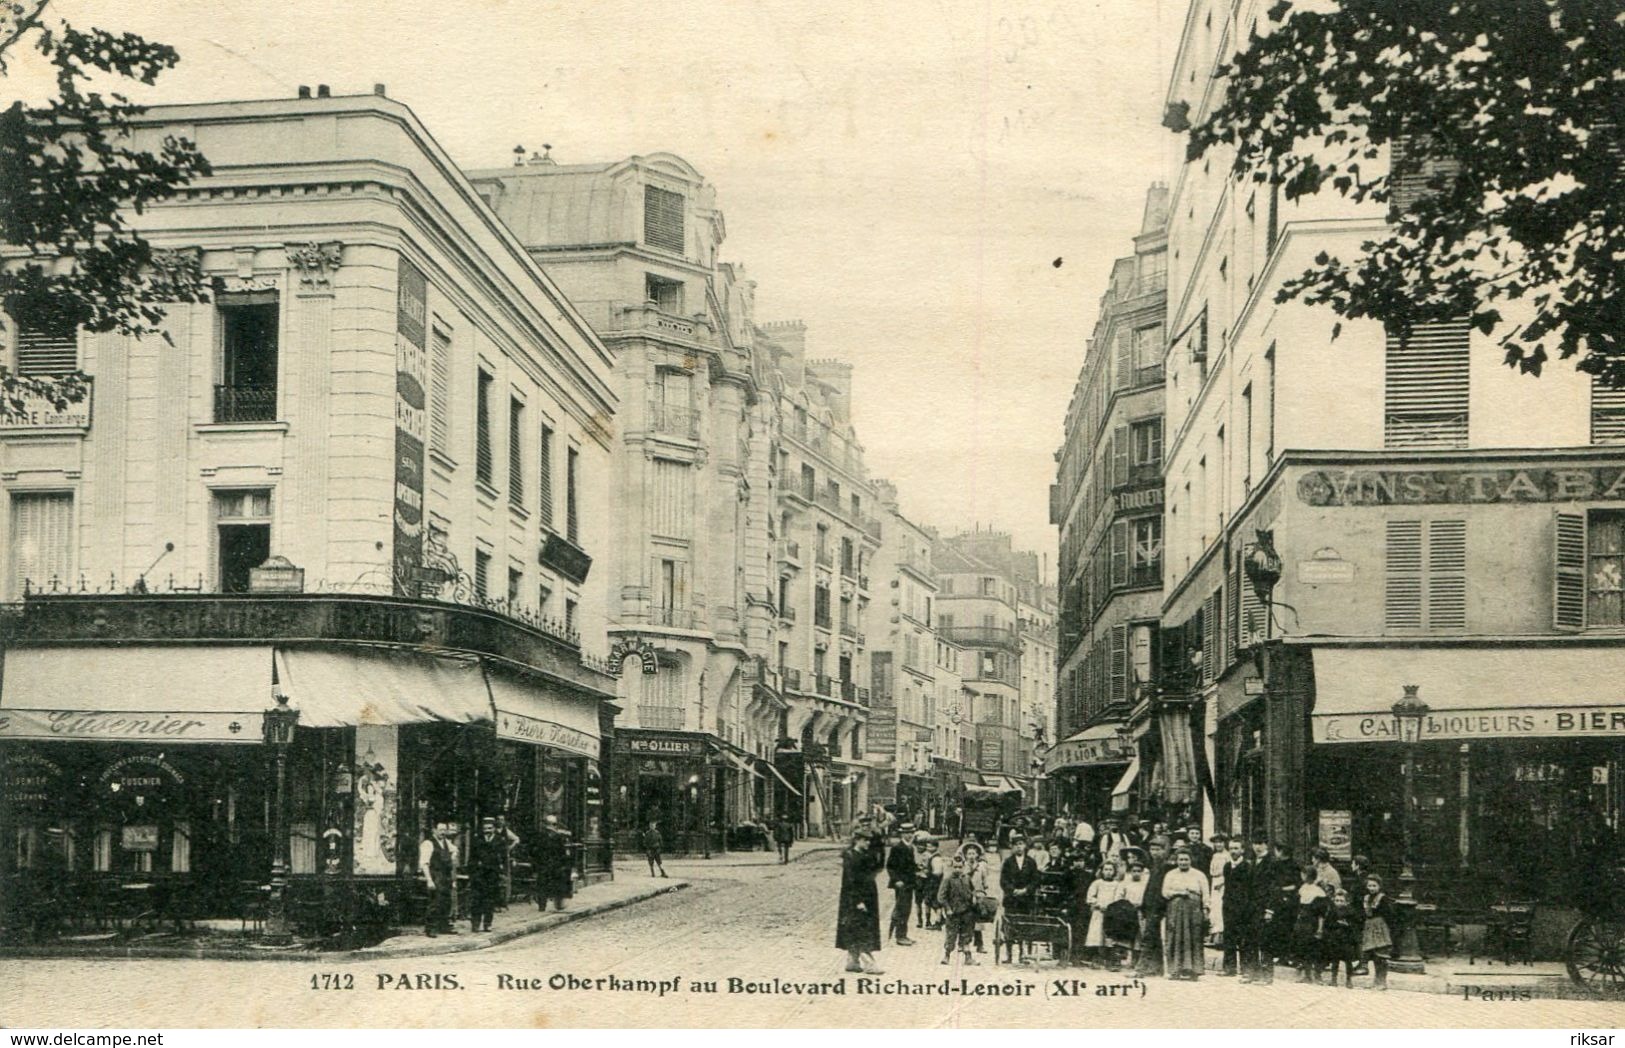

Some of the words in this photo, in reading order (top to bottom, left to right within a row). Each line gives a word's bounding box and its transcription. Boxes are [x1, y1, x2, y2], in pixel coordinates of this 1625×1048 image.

[1326, 470, 1426, 500] VINS
[1427, 715, 1535, 733] LIQUEURS
[649, 740, 690, 752] OLLIER
